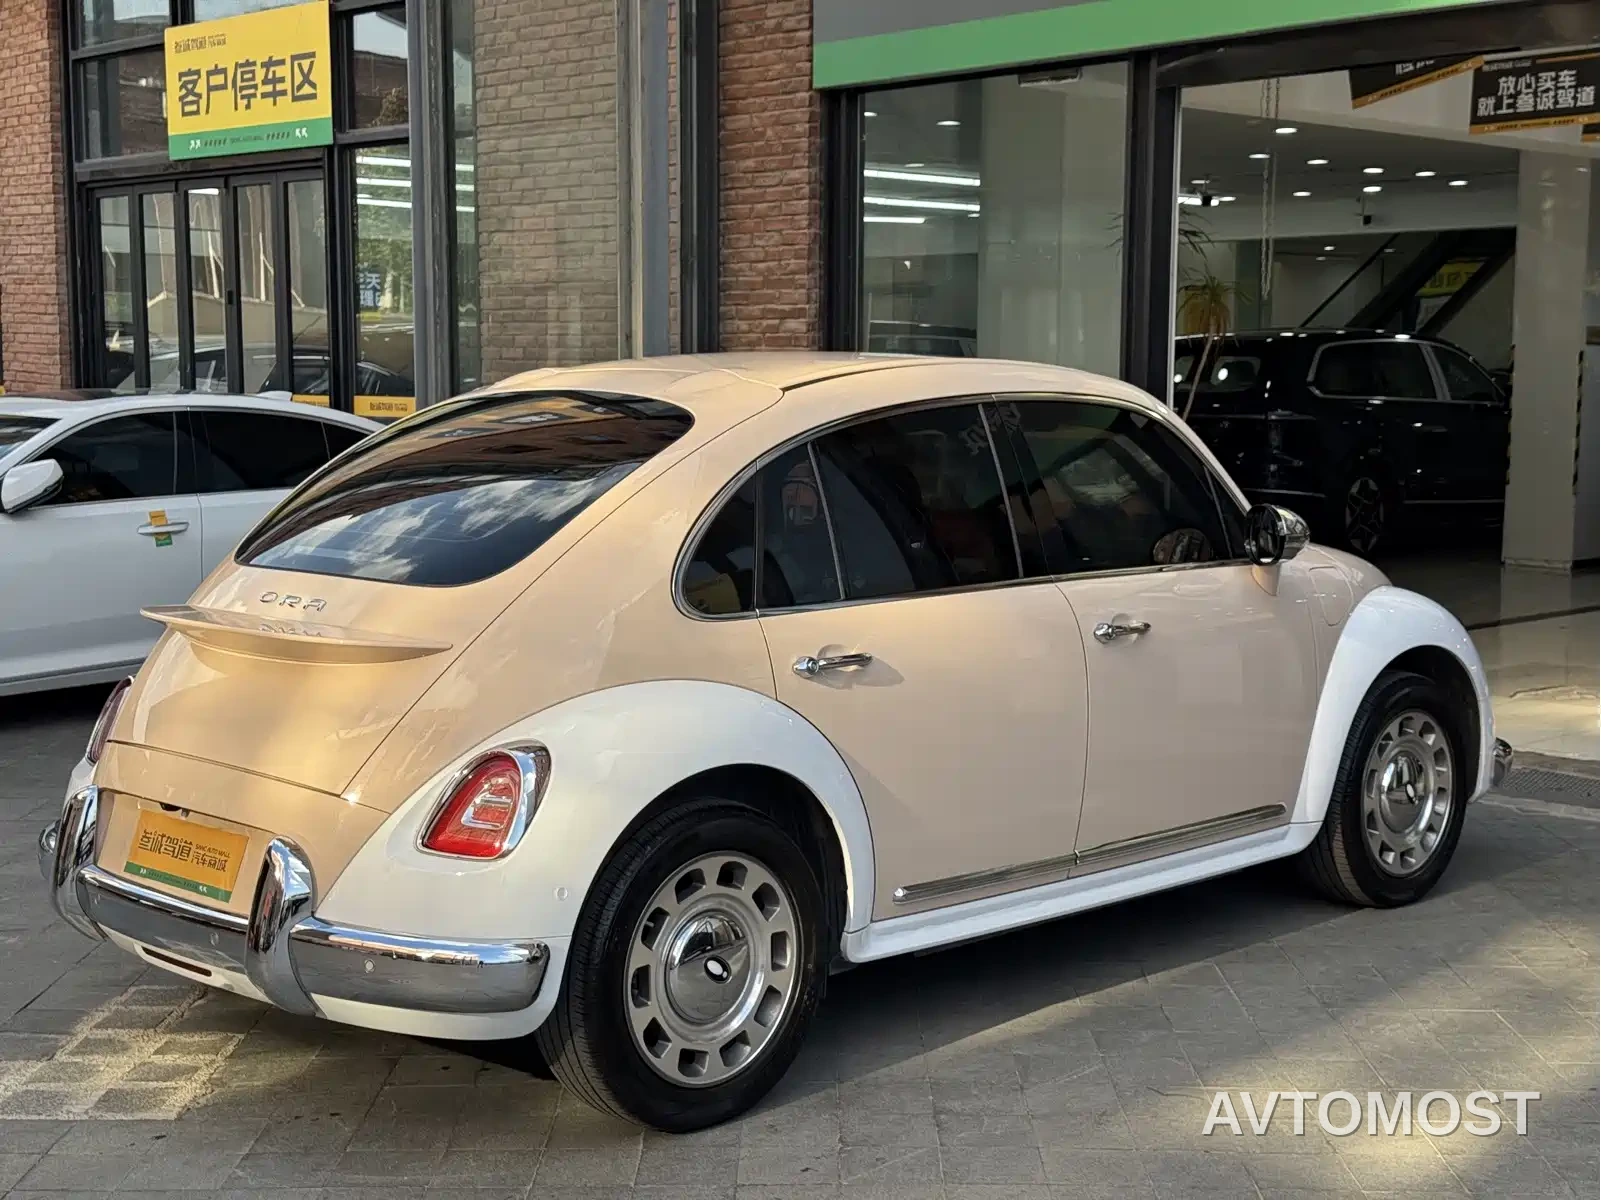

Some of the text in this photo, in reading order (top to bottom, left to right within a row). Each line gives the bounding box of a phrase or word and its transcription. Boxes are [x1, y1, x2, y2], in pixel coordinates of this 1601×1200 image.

[178, 51, 318, 118] 客户停车区
[1497, 69, 1577, 96] 放心买车
[1477, 86, 1595, 117] 就上叁诚驾道
[260, 591, 327, 612] ORA
